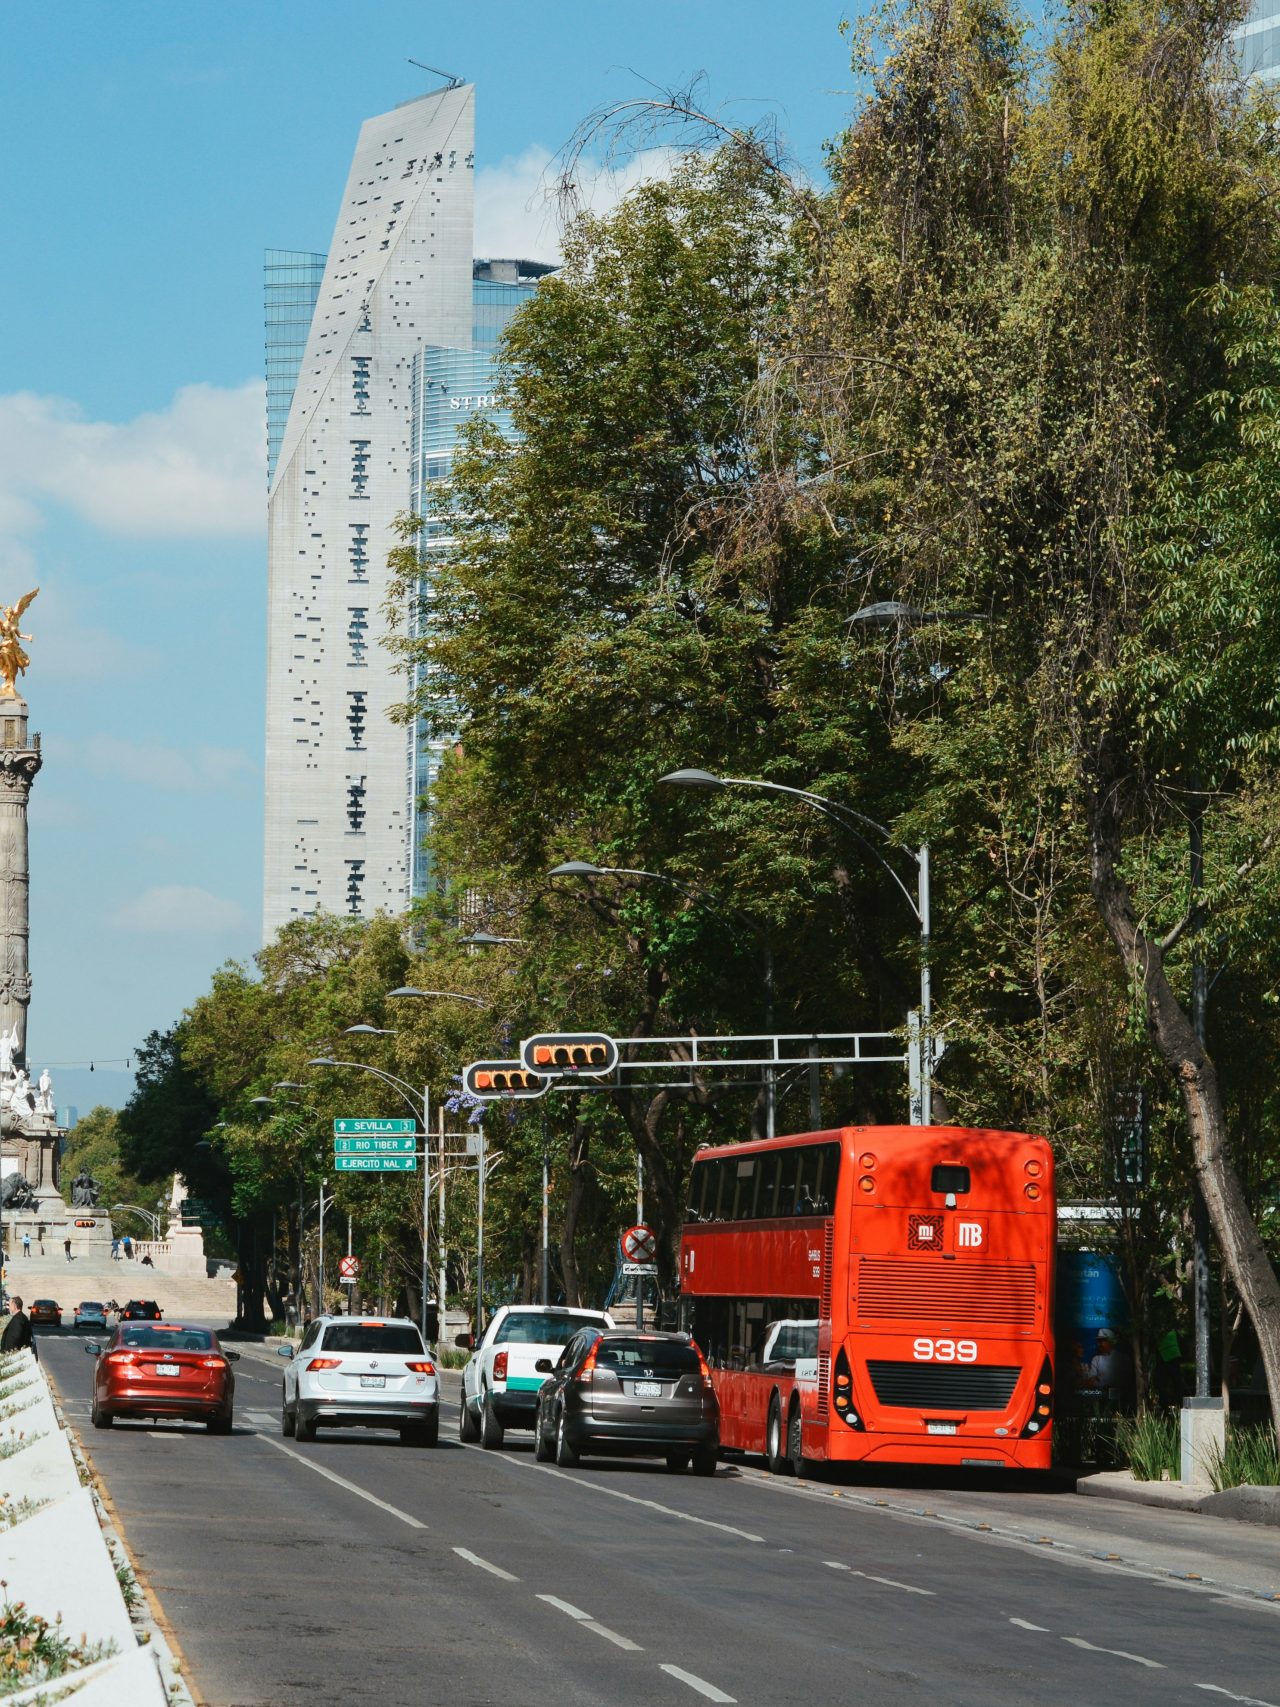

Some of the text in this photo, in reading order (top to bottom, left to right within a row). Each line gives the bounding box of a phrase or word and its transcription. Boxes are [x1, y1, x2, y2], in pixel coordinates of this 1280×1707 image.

[450, 396, 473, 410] ST
[354, 1121, 393, 1131] SEVILLA
[355, 1141, 370, 1150] RIO
[374, 1141, 399, 1150] TIBER
[342, 1159, 401, 1168] EJERCITO NAL
[958, 1223, 983, 1247] MB
[913, 1338, 977, 1362] 939
